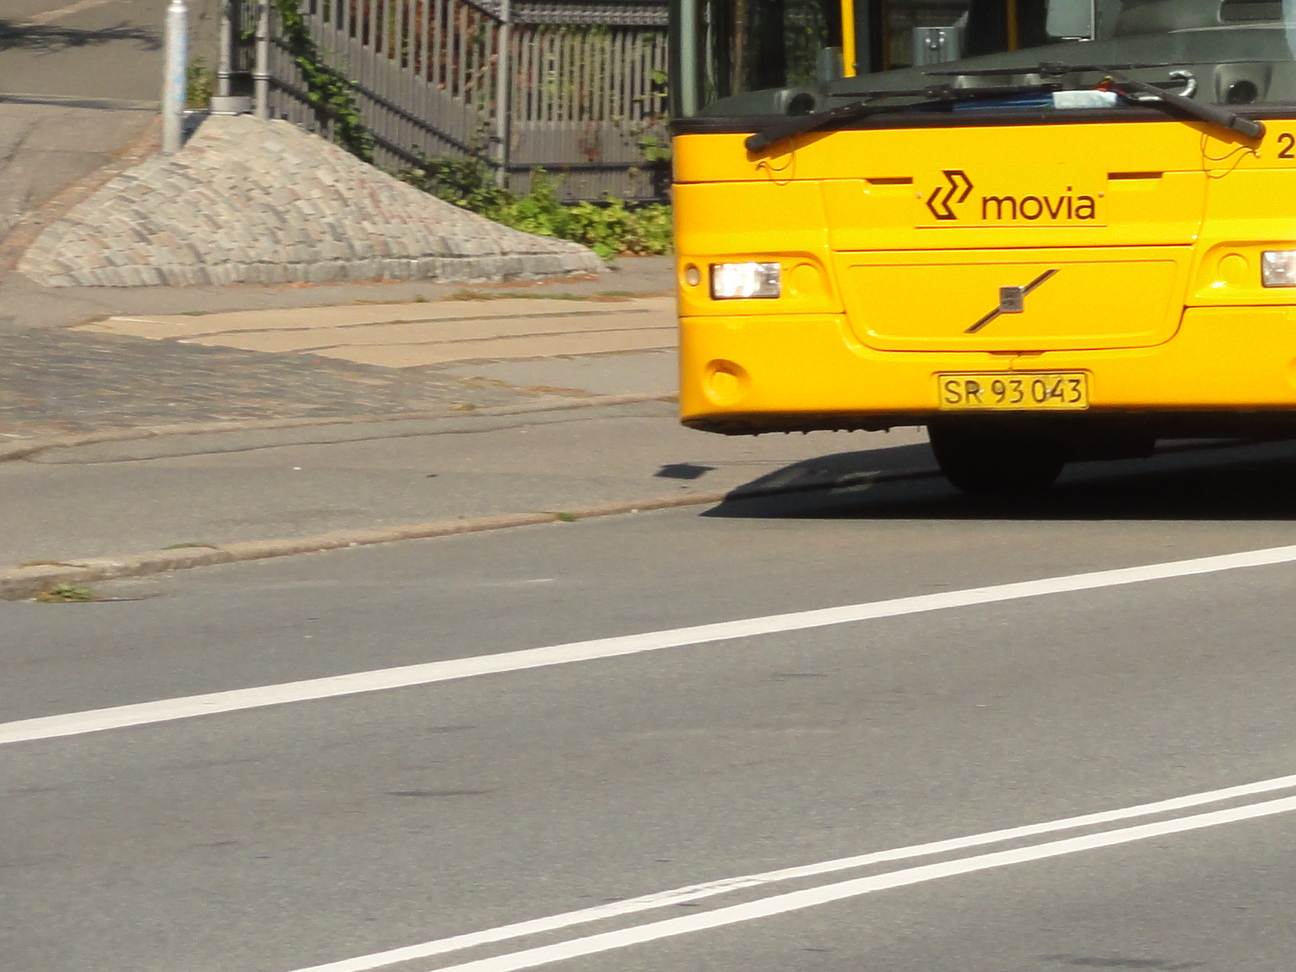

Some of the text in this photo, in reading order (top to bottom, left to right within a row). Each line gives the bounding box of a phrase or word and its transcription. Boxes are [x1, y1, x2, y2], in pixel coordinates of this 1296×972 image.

[981, 186, 1096, 221] movia
[944, 378, 1082, 405] SR 93 043
